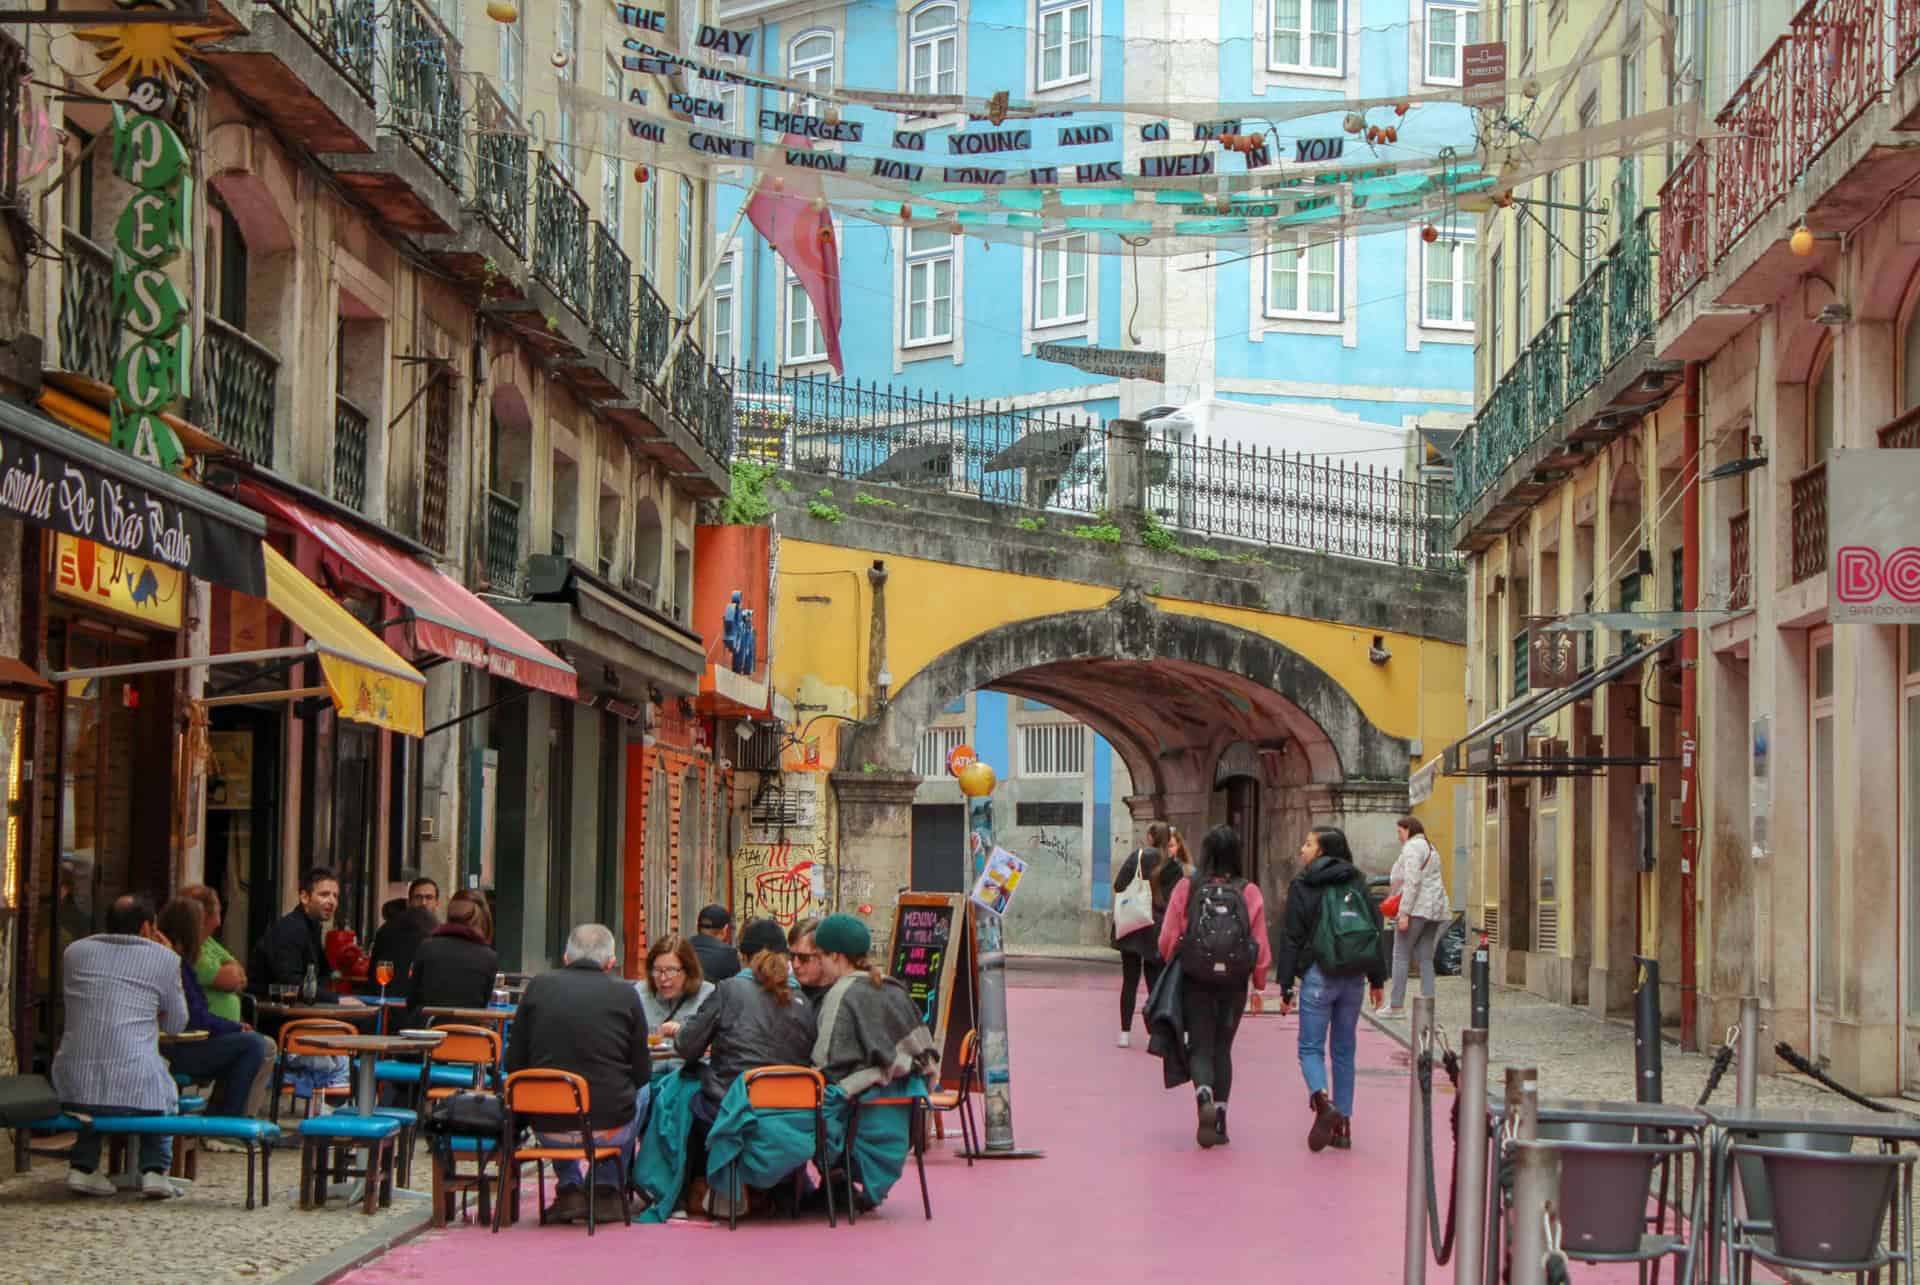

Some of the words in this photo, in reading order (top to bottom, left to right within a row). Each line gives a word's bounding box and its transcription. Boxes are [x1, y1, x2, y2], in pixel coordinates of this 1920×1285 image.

[618, 3, 665, 32] THE
[701, 25, 751, 56] DAY
[628, 117, 665, 143] YOU
[689, 132, 753, 158] CAN'T
[785, 150, 848, 172] KNOW
[1031, 168, 1058, 184] IT
[1076, 161, 1122, 183] HAS
[1247, 144, 1271, 169] IN
[1297, 138, 1343, 162] YOU
[629, 87, 645, 105] A
[668, 92, 724, 120] POEM
[759, 110, 863, 142] EMERGES
[948, 130, 1029, 154] YOUNG
[1060, 125, 1111, 146] AND
[127, 119, 166, 468] PESCA
[60, 537, 111, 598] SOL
